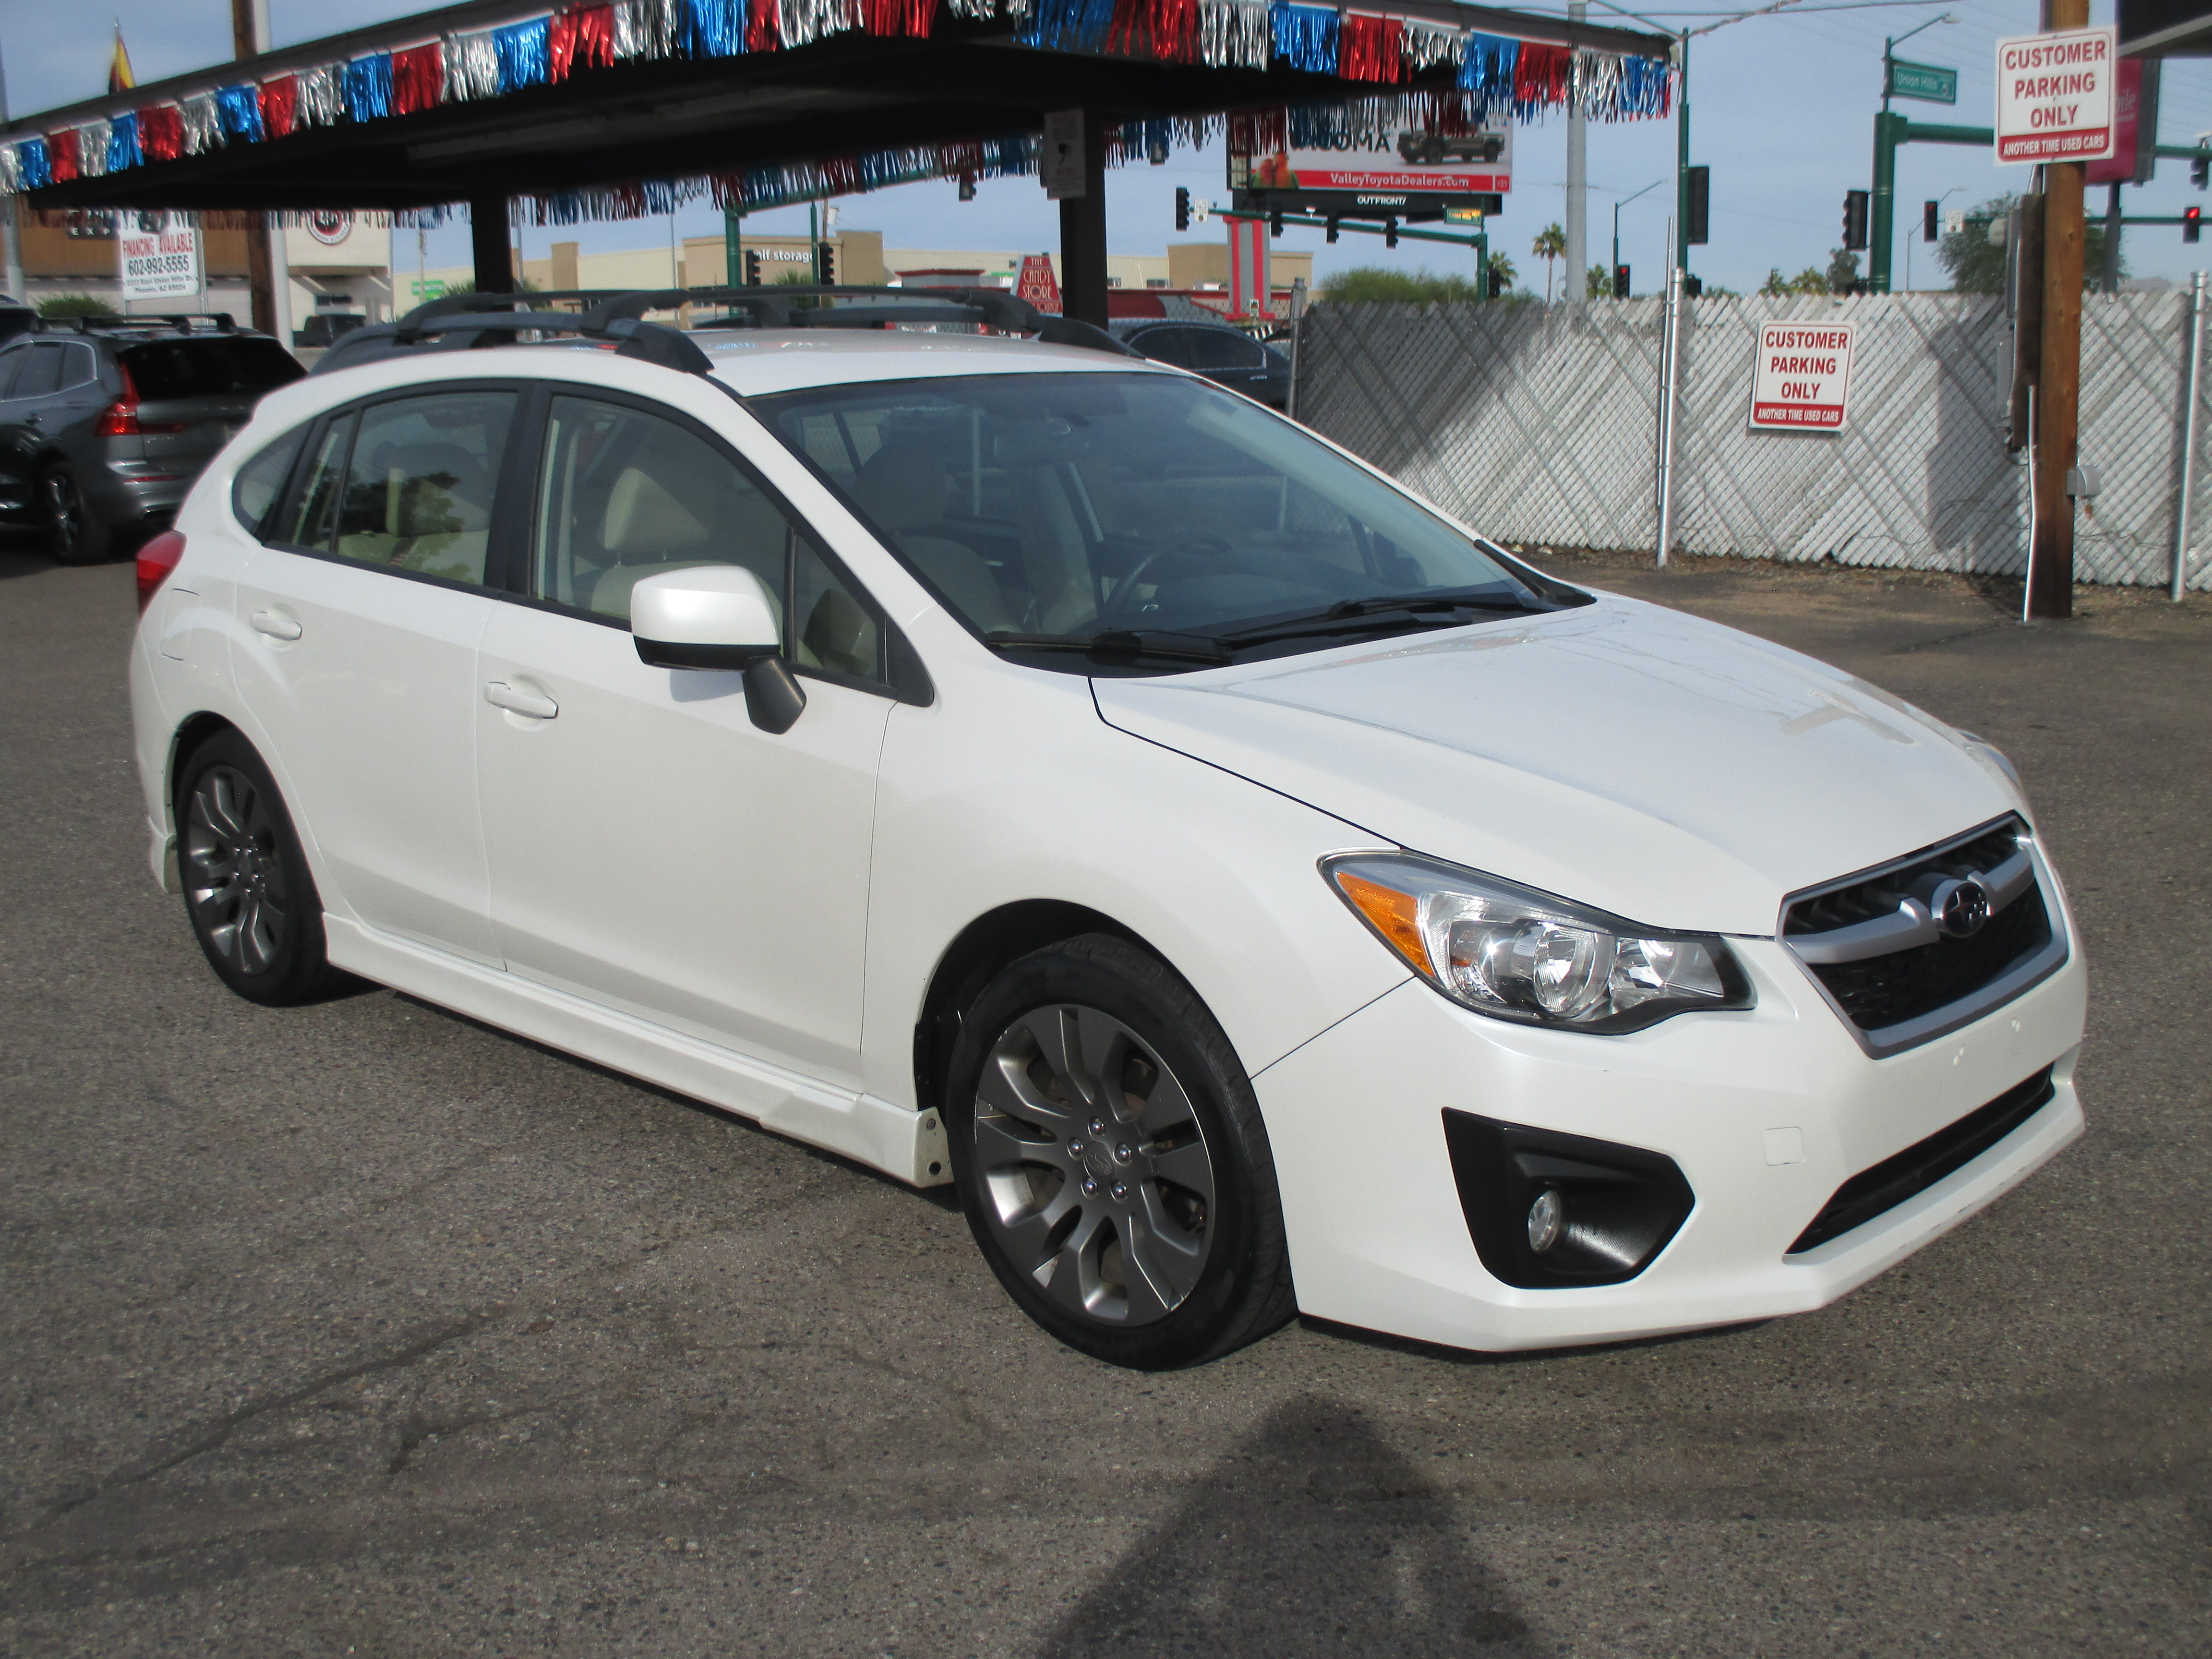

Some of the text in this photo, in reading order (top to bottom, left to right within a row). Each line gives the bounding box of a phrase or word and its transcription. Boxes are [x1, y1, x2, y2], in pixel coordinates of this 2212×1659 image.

[2005, 40, 2105, 71] CUSTOMER
[1897, 72, 1919, 88] Union
[1921, 77, 1937, 91] Hills
[2014, 72, 2095, 100] PARKING
[2030, 104, 2078, 128] ONLY
[2003, 135, 2104, 156] ANOTHER TIME USED CARS
[1330, 172, 1469, 187] ValleyToyotaDealers.com
[123, 233, 193, 259] FINANCING AVAILABLE
[128, 254, 190, 276] 602-992-5555
[1031, 257, 1043, 266] THE
[1023, 269, 1051, 284] CANDY
[1023, 285, 1052, 300] STORE
[1766, 331, 1848, 349] CUSTOMER
[1770, 357, 1836, 374] PARKING
[1780, 382, 1821, 400] ONLY
[1757, 408, 1839, 422] ANOTHER TIME USED CARS
